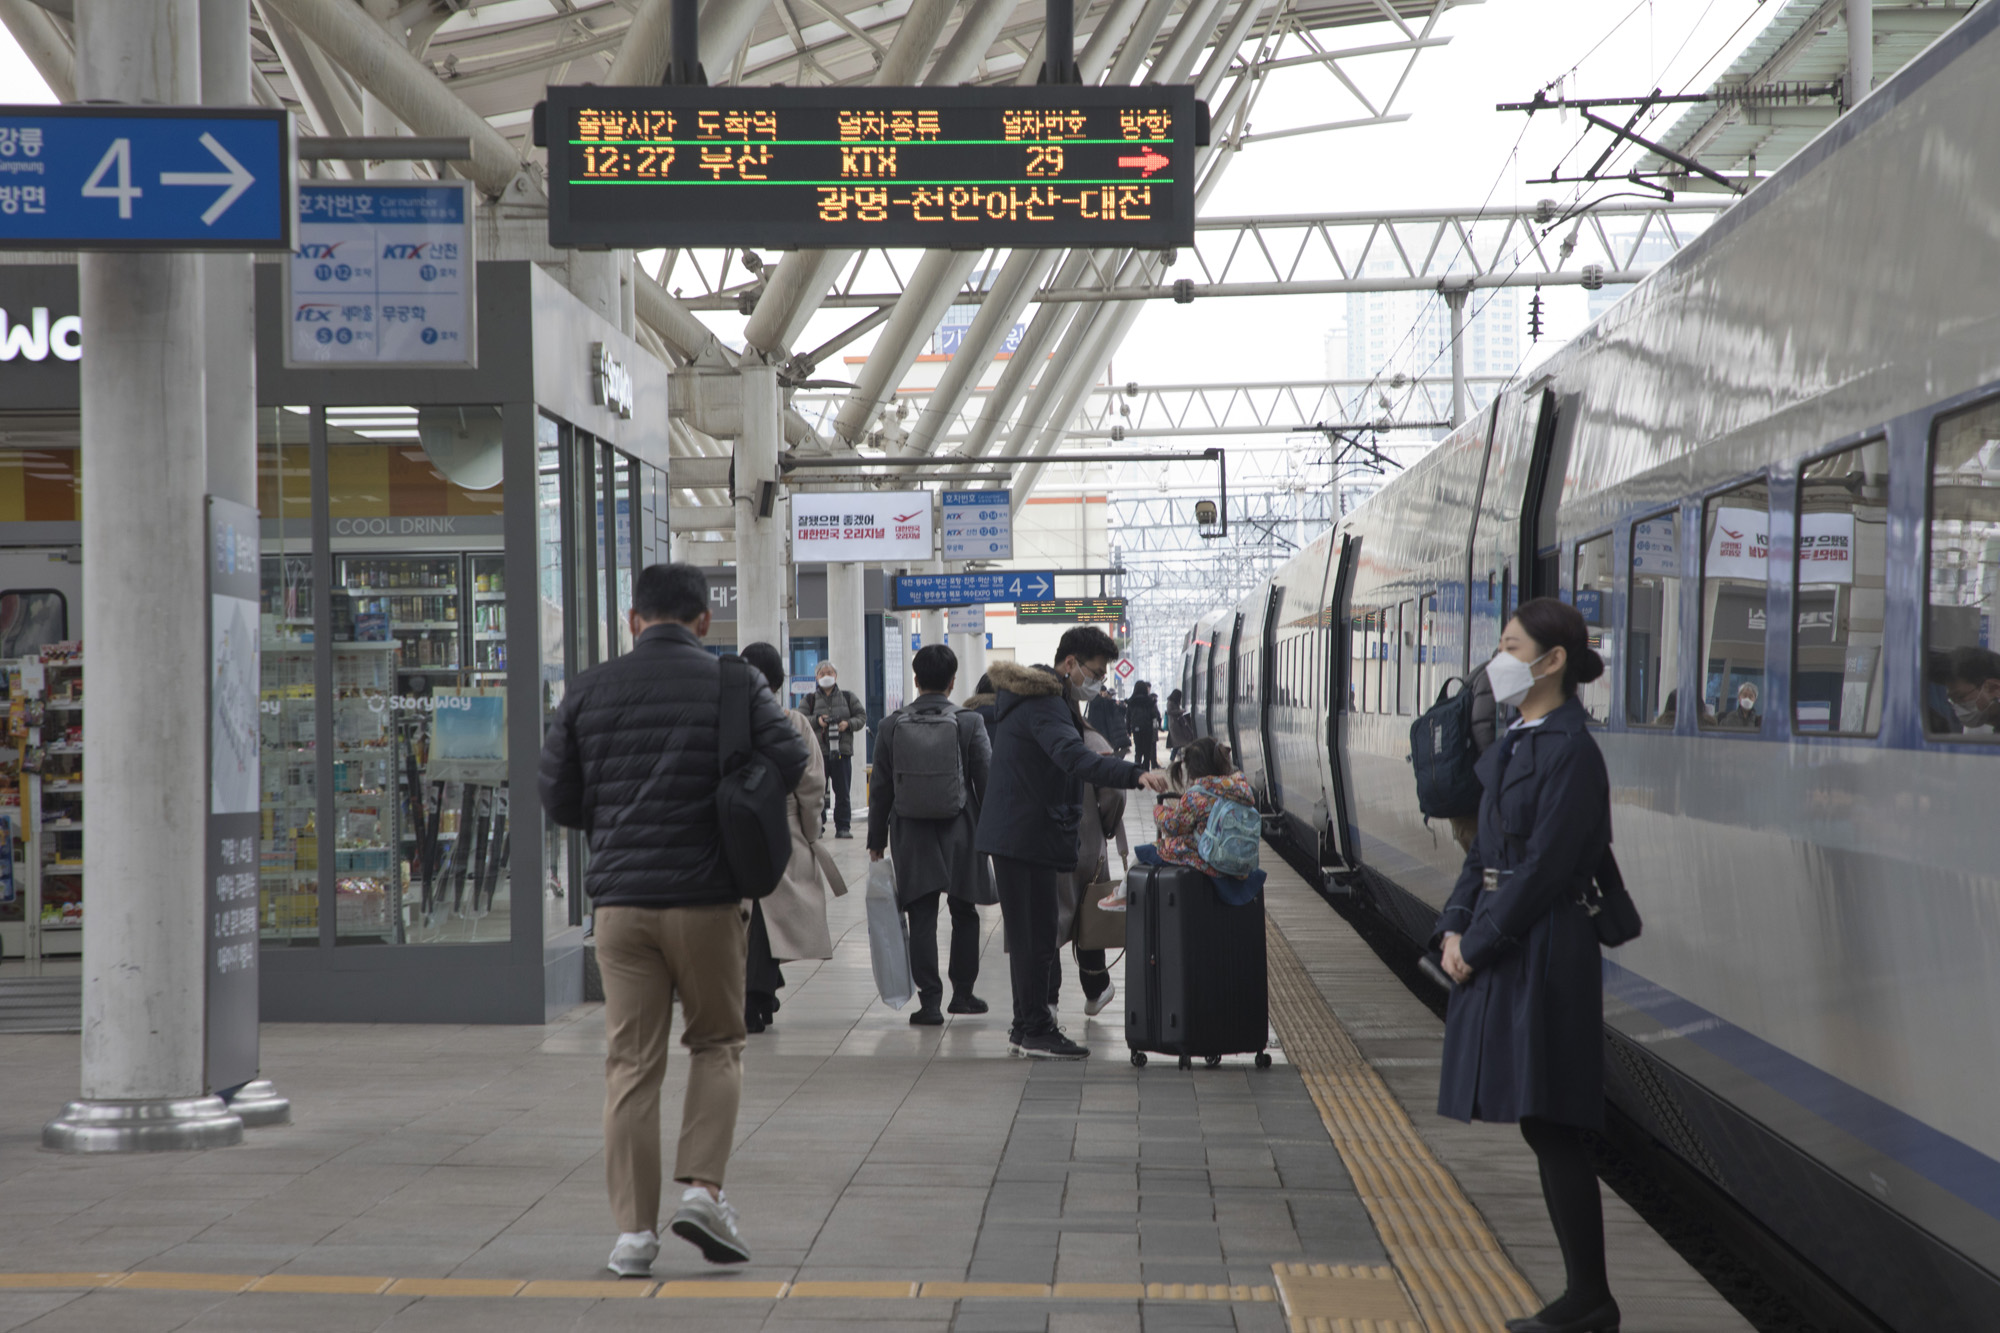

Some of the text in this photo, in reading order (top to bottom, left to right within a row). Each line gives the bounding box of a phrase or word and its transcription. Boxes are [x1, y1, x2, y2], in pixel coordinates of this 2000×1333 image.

[578, 109, 1172, 142] 출발시간 도착역 열차종류 열차번호 방향
[583, 145, 1064, 180] 12:27 부산 KTX 29
[81, 138, 143, 219] 4
[299, 193, 374, 217] 호차번호
[295, 241, 346, 259] KTX
[383, 242, 458, 260] KTX 산천
[382, 305, 427, 323] 무궁화
[336, 517, 456, 535] COOL DRINK
[798, 528, 885, 540] 대한민국 오리지널
[1009, 577, 1023, 597] 4
